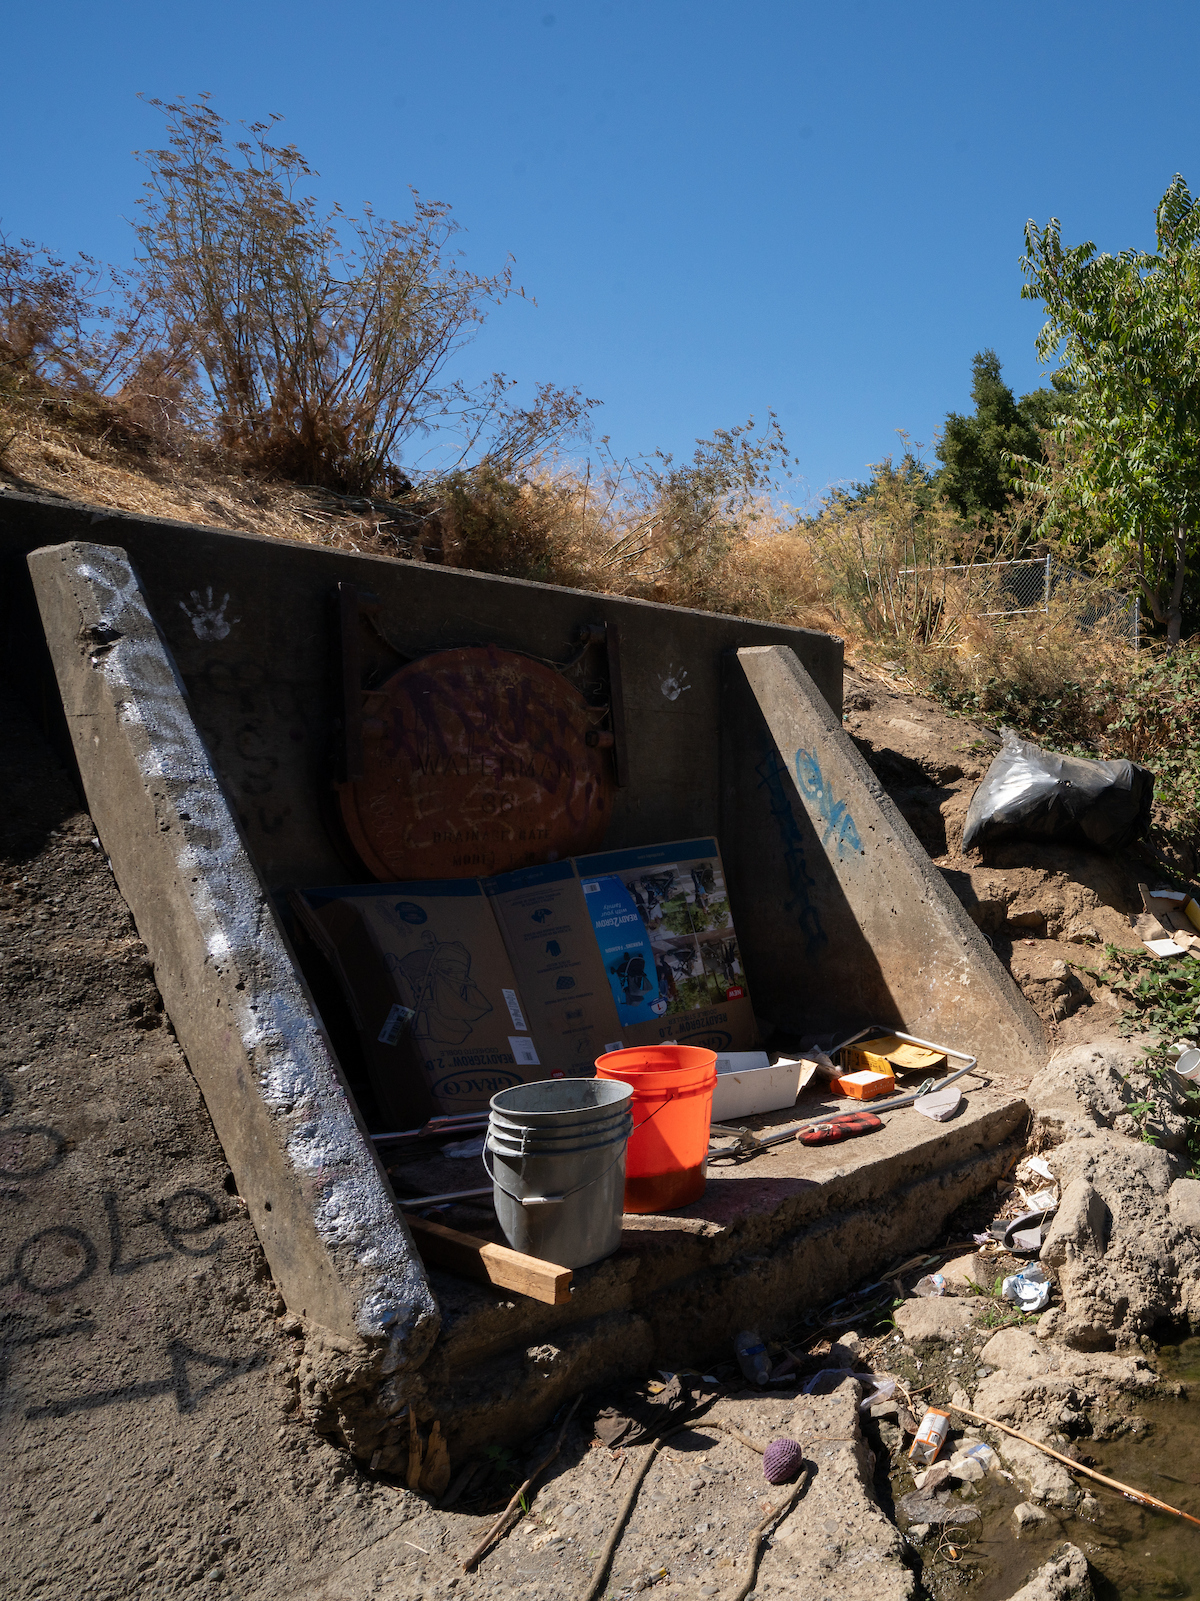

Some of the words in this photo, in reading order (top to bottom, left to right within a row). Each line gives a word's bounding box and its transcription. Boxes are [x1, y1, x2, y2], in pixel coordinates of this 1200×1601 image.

[417, 754, 572, 777] WATERMAN
[481, 793, 515, 814] 36
[603, 902, 621, 910] family
[601, 908, 614, 918] your
[595, 913, 638, 929] READY2GROW
[605, 945, 623, 953] FASHION
[729, 989, 742, 998] NEW
[658, 1027, 673, 1038] 2.0
[426, 1058, 445, 1071] 2.0
[443, 1076, 511, 1096] GRACO
